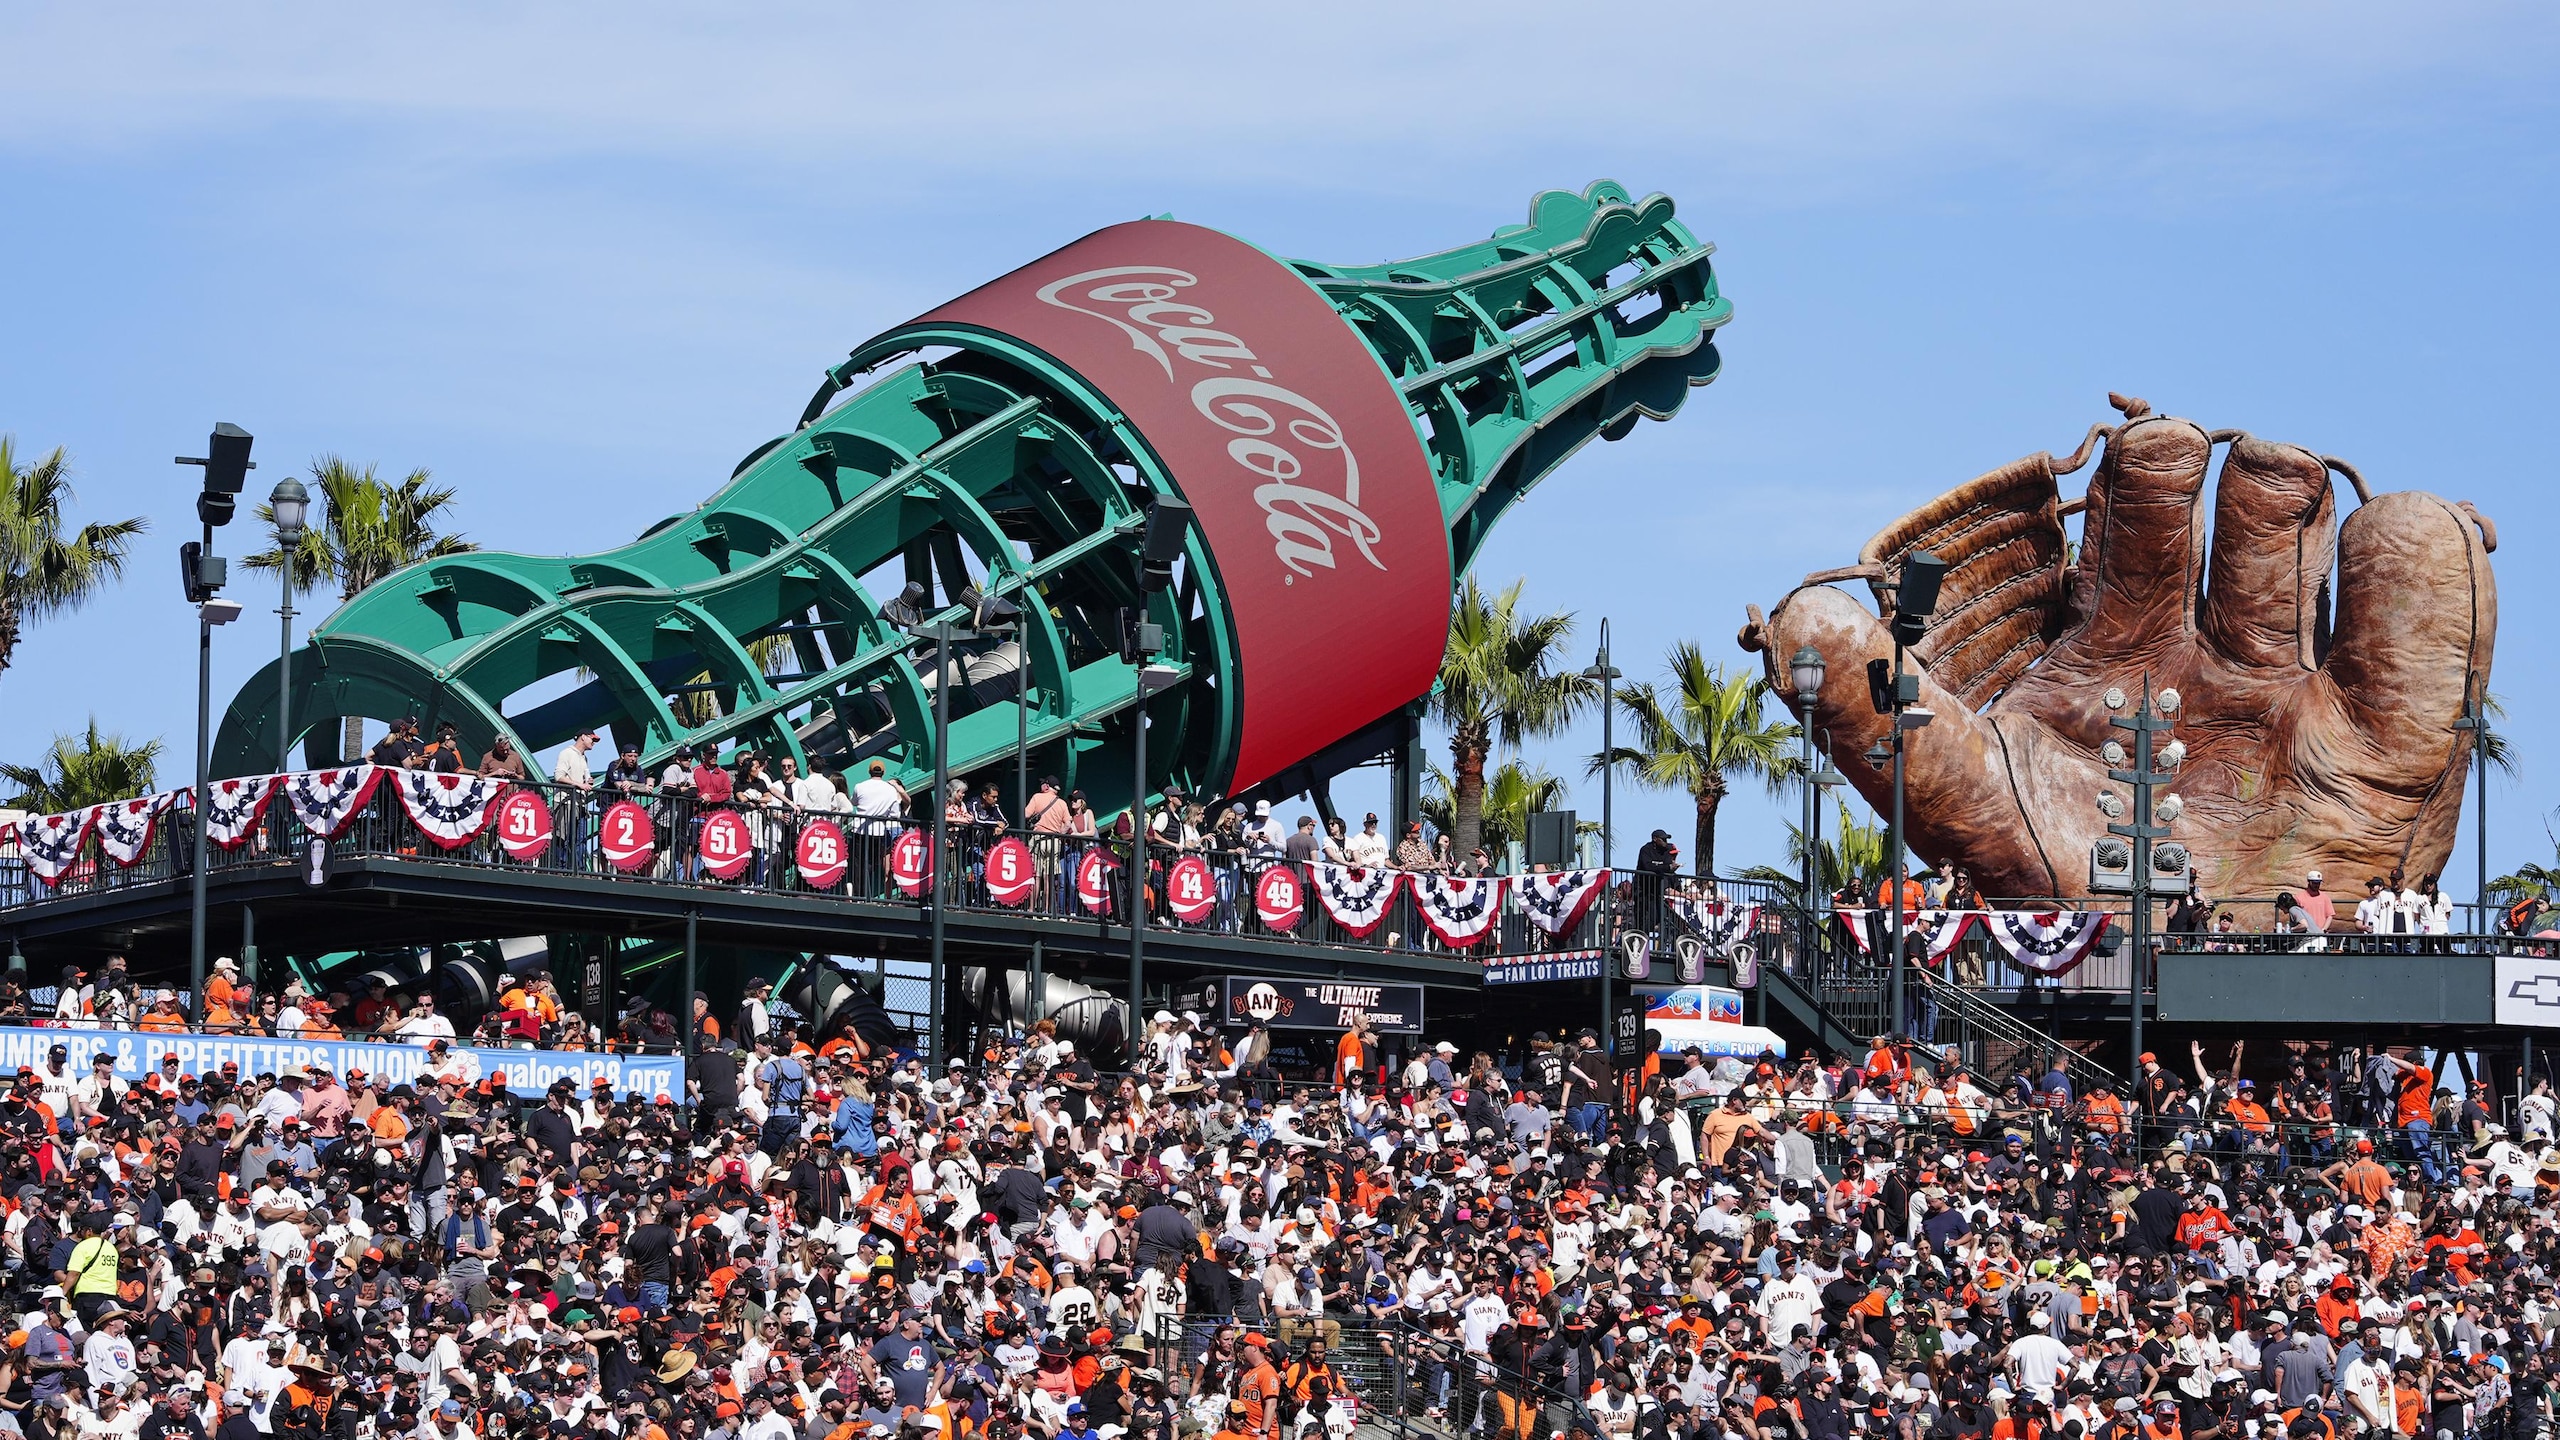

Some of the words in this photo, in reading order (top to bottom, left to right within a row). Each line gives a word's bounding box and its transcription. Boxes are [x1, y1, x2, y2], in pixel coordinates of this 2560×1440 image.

[1036, 265, 1388, 579] Coca-Cola
[517, 799, 532, 808] Enjoy
[509, 808, 537, 836] 31
[619, 809, 635, 818] Enjoy
[718, 818, 733, 827] Enjoy
[618, 818, 634, 846] 2
[710, 826, 737, 855] 51
[814, 828, 828, 837] Enjoy
[807, 836, 838, 865] 26
[909, 837, 925, 846] Enjoy
[1002, 846, 1017, 855] Enjoy
[902, 845, 928, 873] 17
[1001, 854, 1017, 882] 5
[1184, 865, 1198, 874] Enjoy
[1273, 873, 1286, 882] Enjoy
[1180, 872, 1203, 900] 14
[1266, 881, 1293, 909] 49
[586, 962, 601, 987] 138
[1505, 966, 1526, 982] FAN
[1531, 964, 1553, 980] LOT
[1556, 960, 1599, 978] TREATS
[1305, 986, 1318, 998] THE
[1319, 984, 1382, 1007] ULTIMATE
[1232, 992, 1295, 1018] GIANTS
[1366, 1012, 1404, 1025] EXPERIENCE
[1618, 1014, 1636, 1038] 139
[1670, 1038, 1709, 1054] TASTE
[1713, 1041, 1727, 1054] the
[1730, 1041, 1761, 1056] FUN!
[116, 1037, 137, 1073] &
[337, 1048, 425, 1085] UNION
[498, 1058, 672, 1097] ualocal38.org
[1545, 1068, 1562, 1086] 25
[2523, 1109, 2532, 1125] 5
[101, 1255, 116, 1267] 395
[1156, 1286, 1176, 1306] 28
[1772, 1290, 1806, 1304] GIANTS
[2030, 1290, 2053, 1309] 22
[1064, 1302, 1091, 1325] 28
[1473, 1307, 1502, 1316] GIANTS
[1006, 1354, 1035, 1364] GIANTS
[1242, 1388, 1260, 1402] 40
[1604, 1411, 1627, 1423] GIANT
